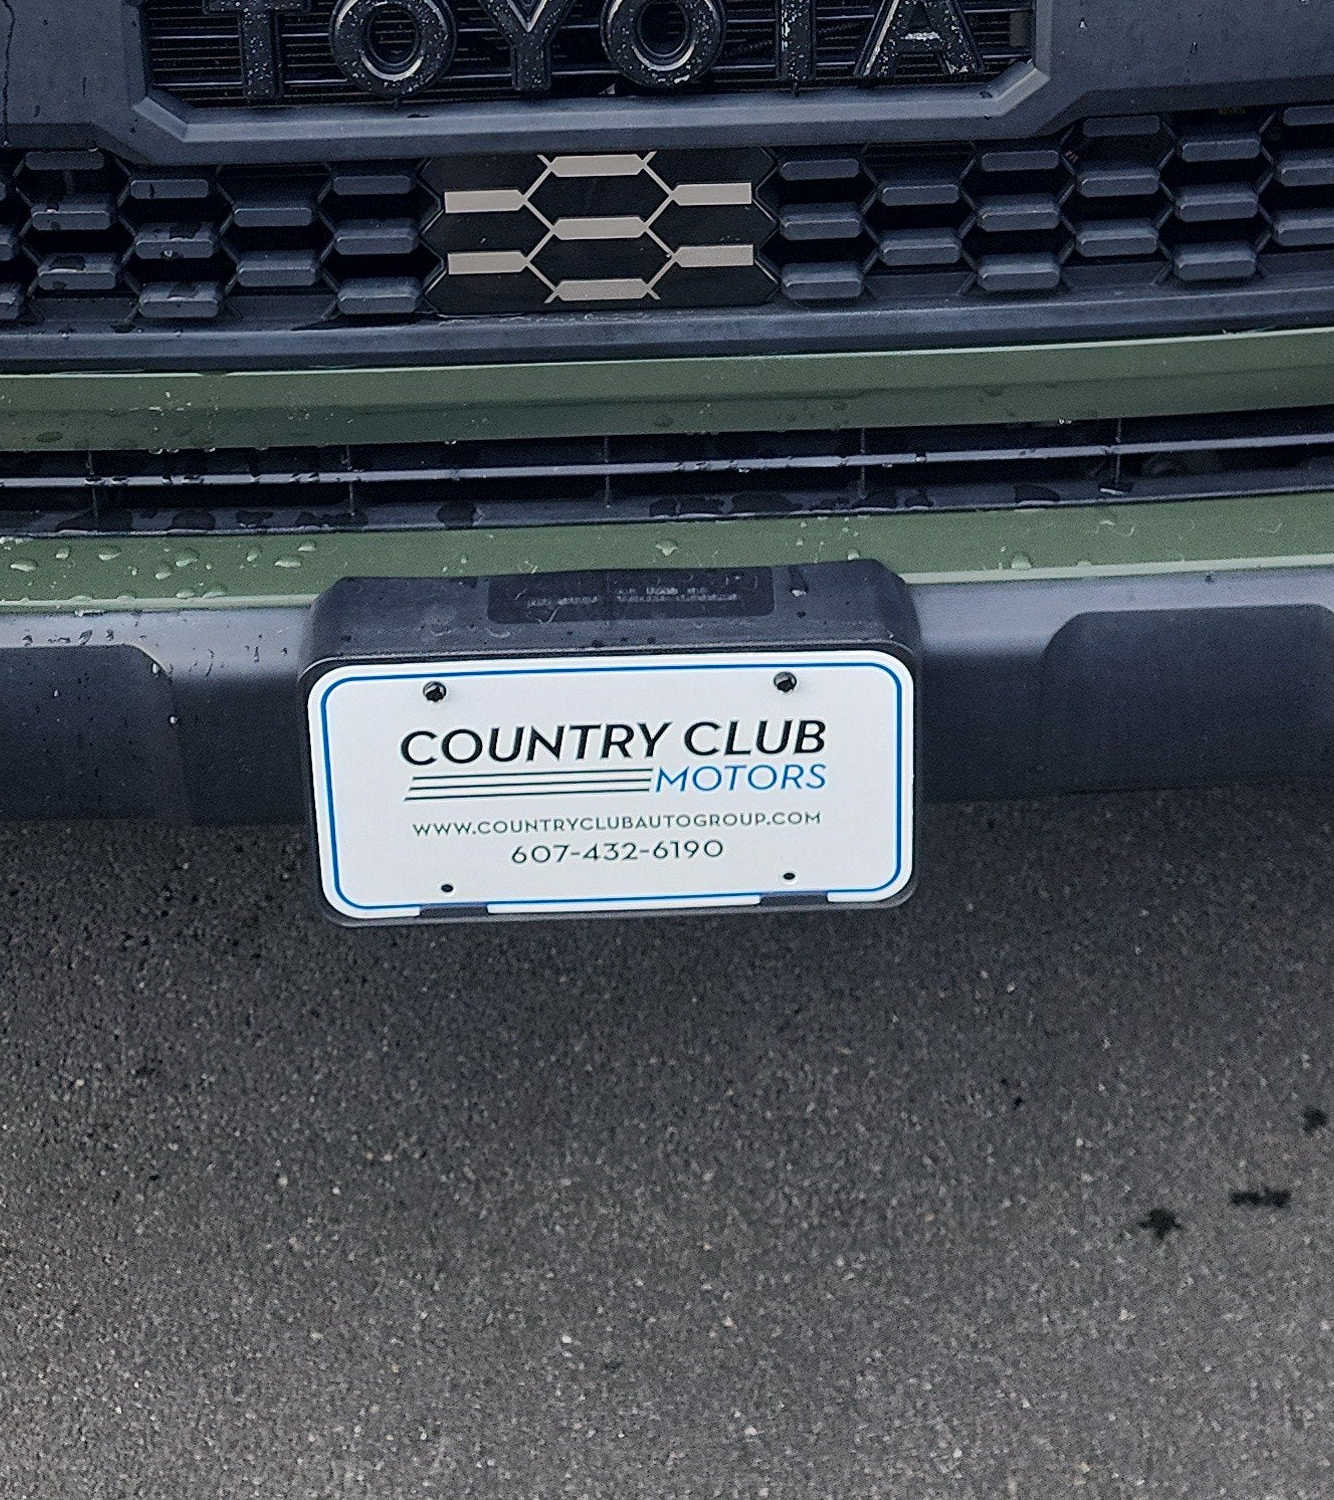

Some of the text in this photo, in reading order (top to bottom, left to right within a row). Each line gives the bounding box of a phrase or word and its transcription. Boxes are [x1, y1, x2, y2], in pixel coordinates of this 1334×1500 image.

[400, 718, 827, 767] COUNTRY CLUB
[655, 764, 827, 792] MOTORS
[412, 811, 822, 837] WWW.COUNTRYCLUBAUTOGROUP.COM
[510, 839, 724, 865] 607-432-6190
